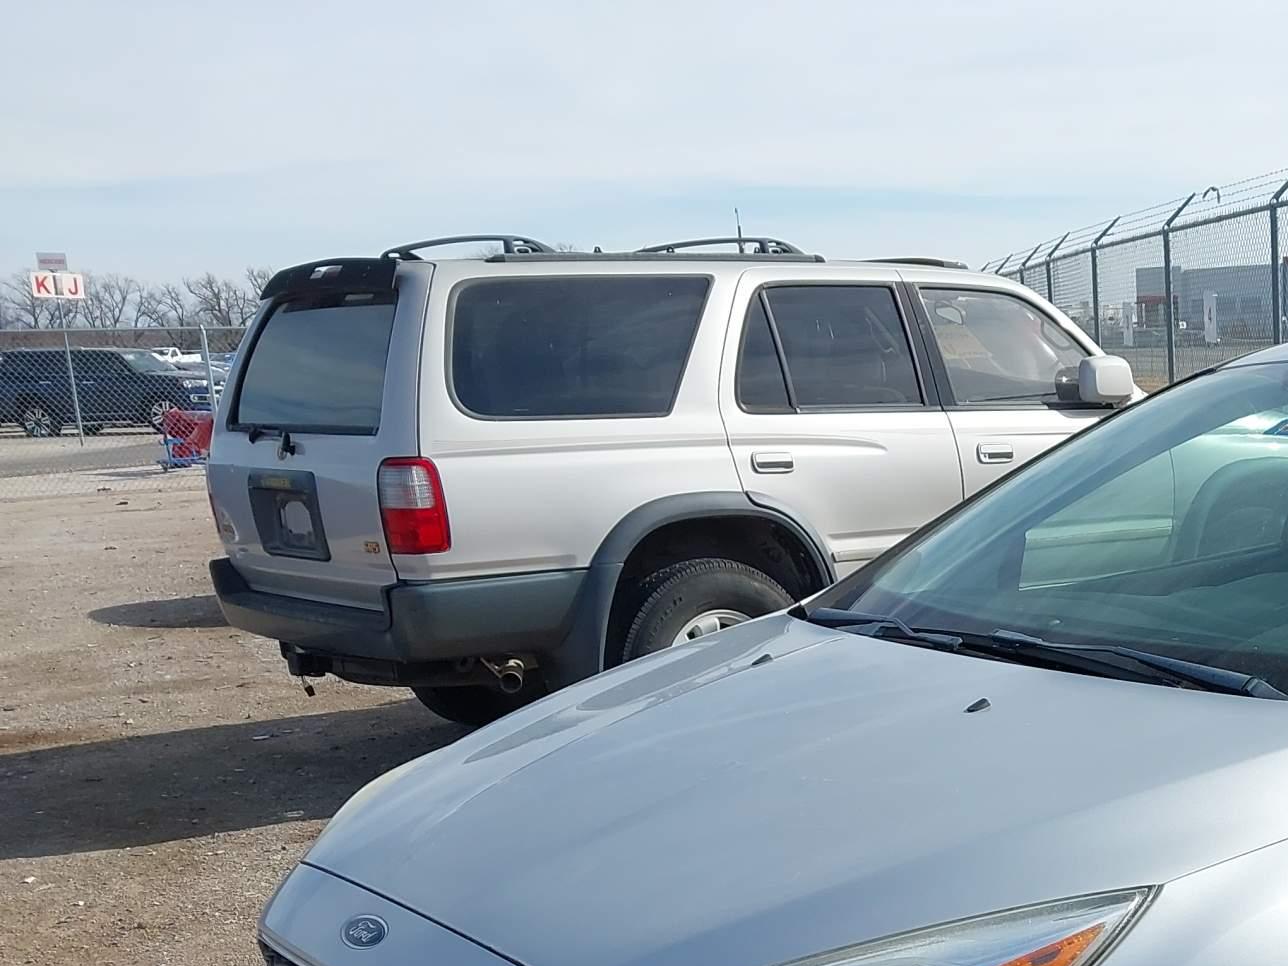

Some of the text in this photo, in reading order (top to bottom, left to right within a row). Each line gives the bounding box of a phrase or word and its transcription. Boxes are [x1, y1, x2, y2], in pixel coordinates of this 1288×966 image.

[34, 275, 78, 296] K J
[349, 920, 377, 942] Ford
